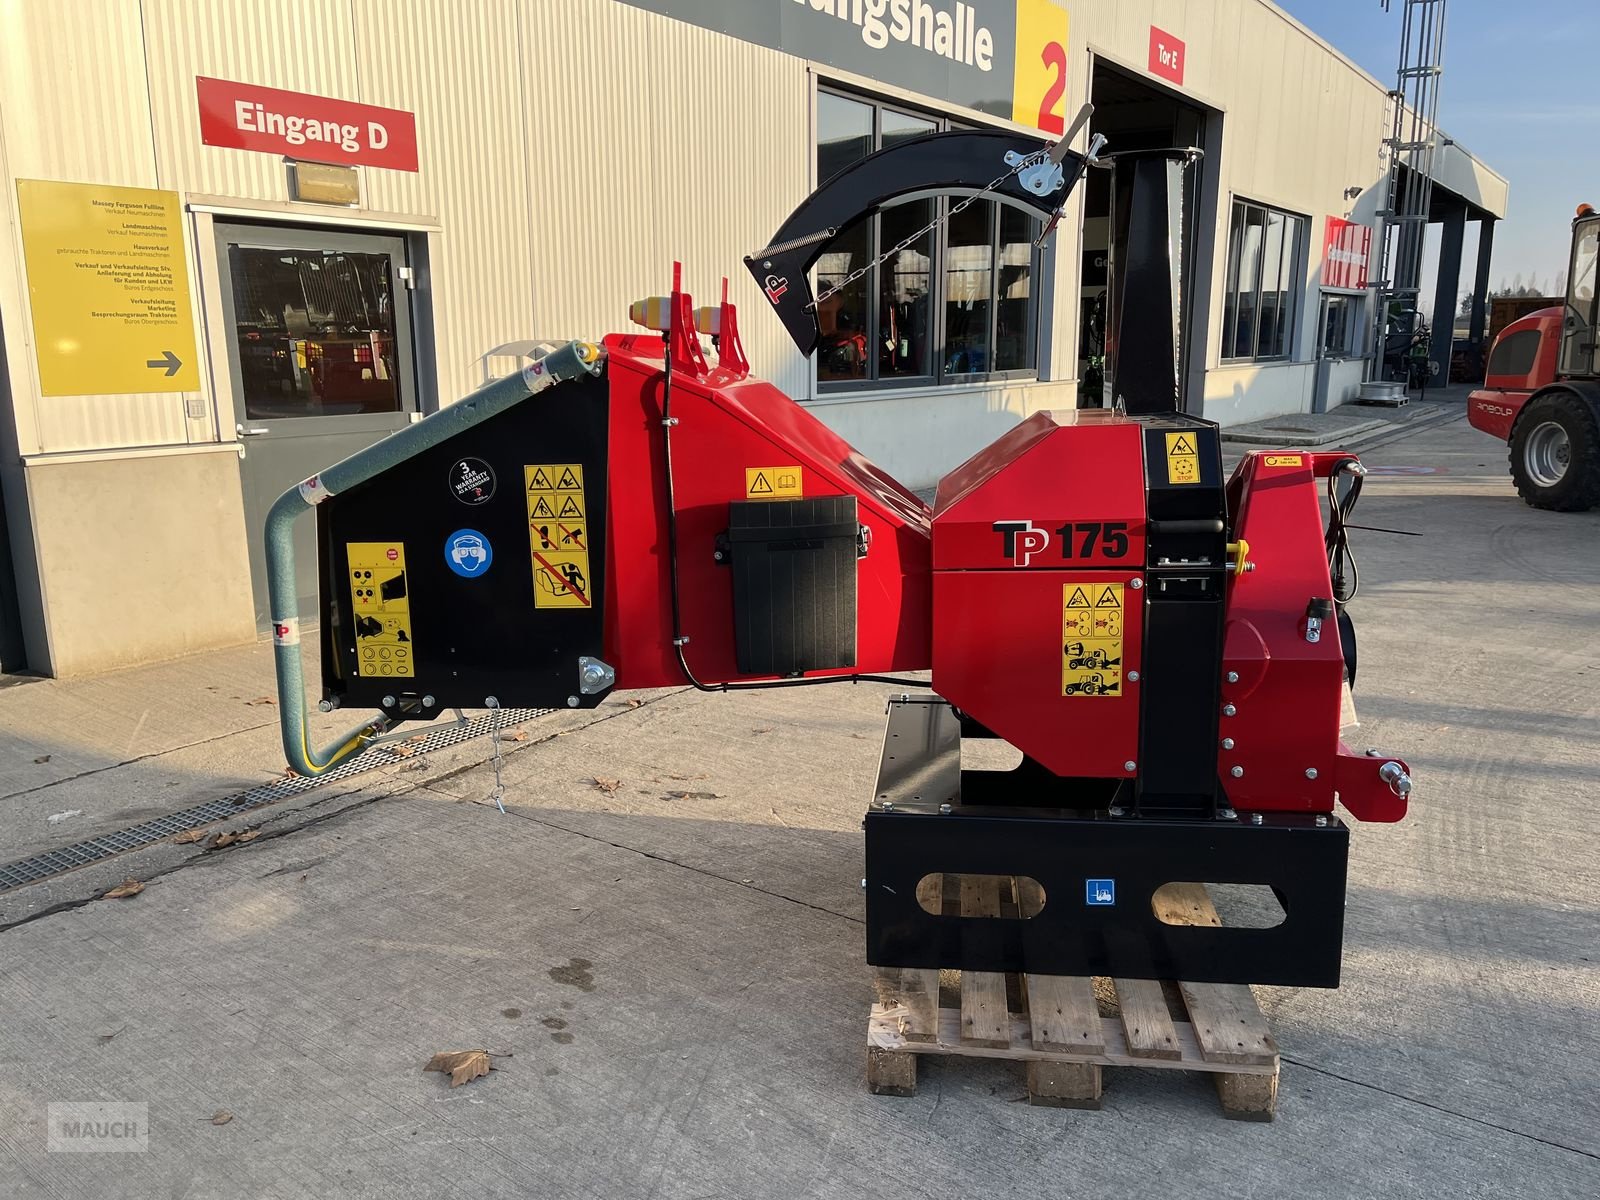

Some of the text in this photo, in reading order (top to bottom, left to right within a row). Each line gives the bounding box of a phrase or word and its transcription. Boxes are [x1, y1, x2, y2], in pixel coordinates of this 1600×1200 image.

[1158, 42, 1178, 70] Tor E
[793, 0, 1066, 135] ngshalle 2
[234, 99, 388, 153] Eingang D
[92, 200, 114, 208] Massey
[127, 209, 165, 217] Neumaschinen
[122, 222, 167, 230] Landmaschinen
[129, 230, 168, 238] Neumaschinen
[764, 274, 788, 304] TP
[460, 462, 470, 474] 3
[461, 470, 477, 481] YEAR
[455, 470, 487, 490] WARRANTY
[992, 520, 1129, 568] TP 175
